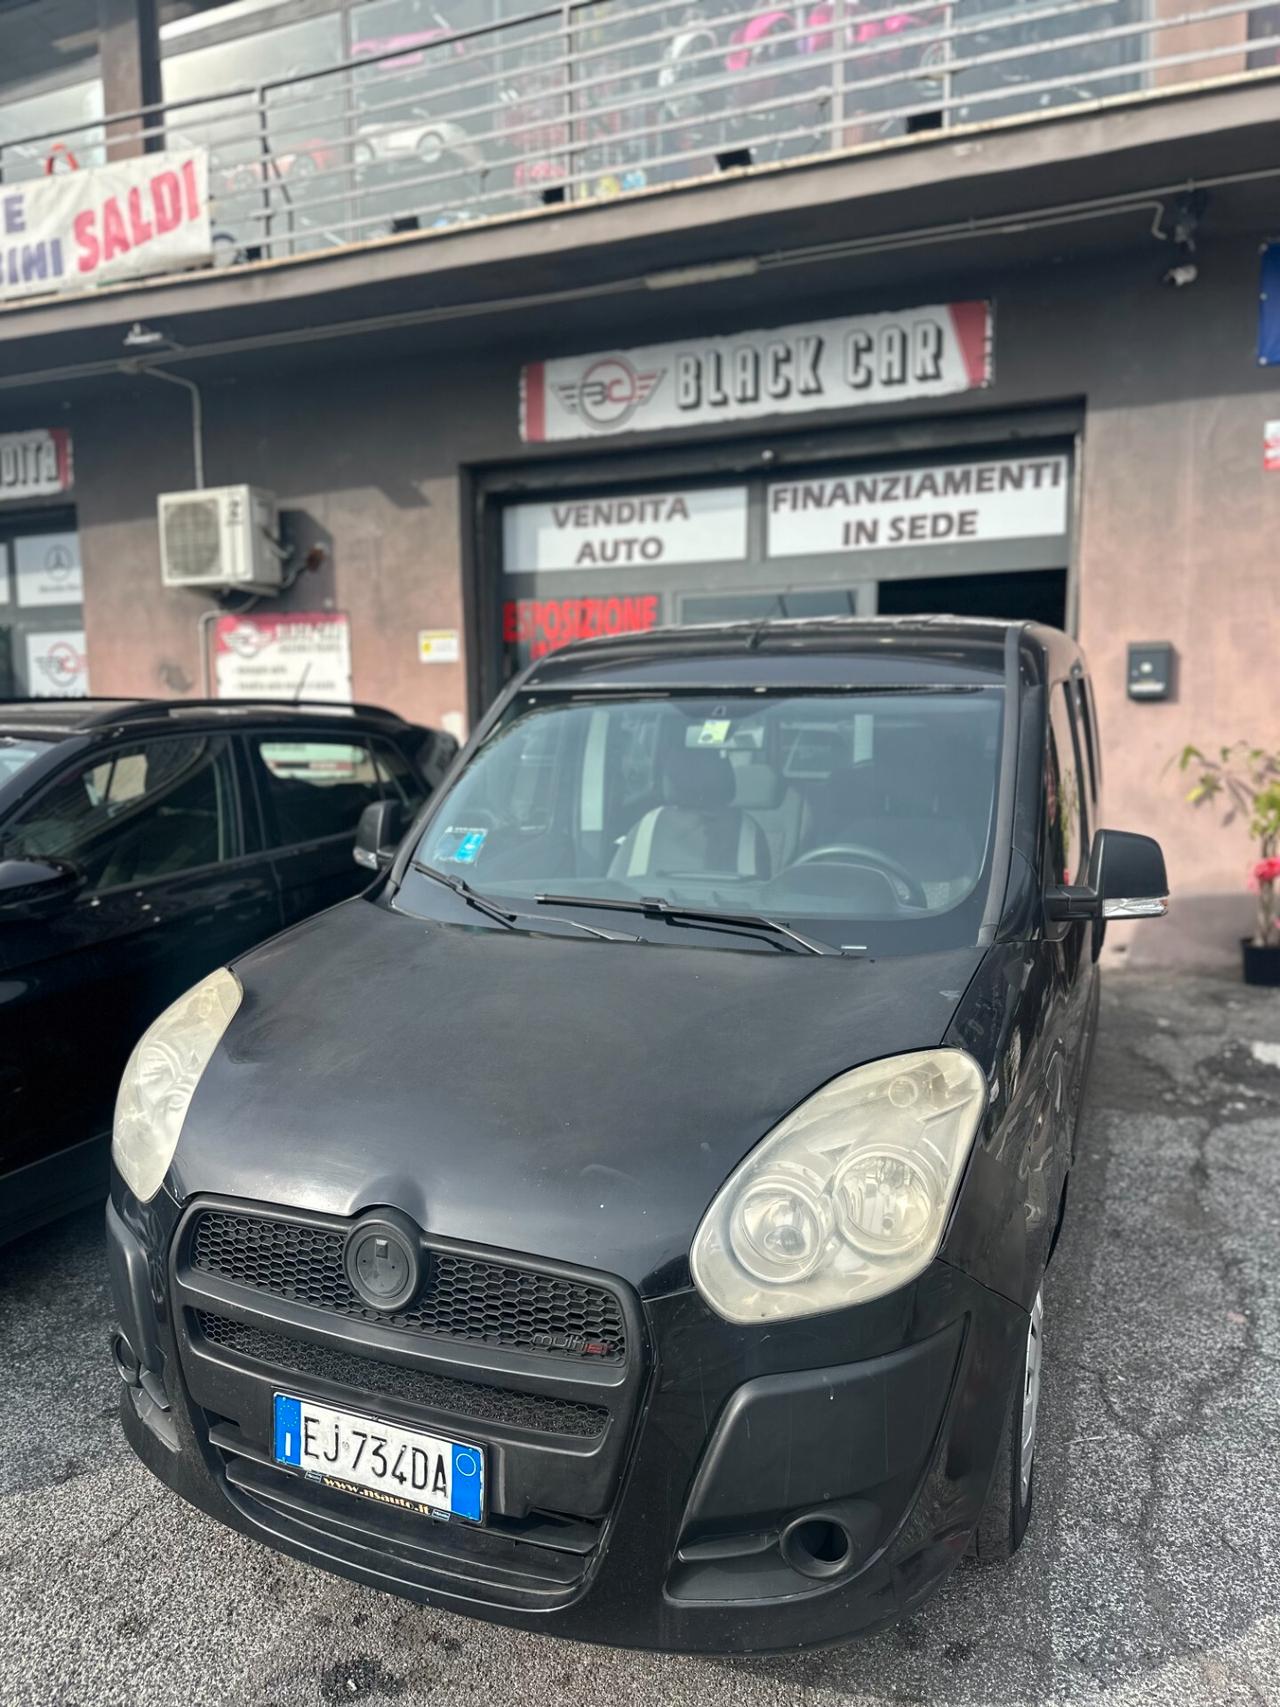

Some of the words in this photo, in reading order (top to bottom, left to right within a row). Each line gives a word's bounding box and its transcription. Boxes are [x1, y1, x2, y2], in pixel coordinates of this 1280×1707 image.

[5, 194, 26, 235] E
[73, 159, 200, 273] SALDI
[675, 335, 823, 411] BLACK
[843, 319, 943, 388] CAR
[0, 440, 60, 488] DITA
[772, 461, 1062, 514] FINANZIAMENTI
[553, 497, 689, 529] VENDITA
[842, 519, 879, 547] IN
[889, 510, 979, 543] SEDE
[575, 537, 664, 565] AUTO
[503, 595, 659, 642] ESPOSIZIONE
[323, 1477, 432, 1515] www.nsauto.it
